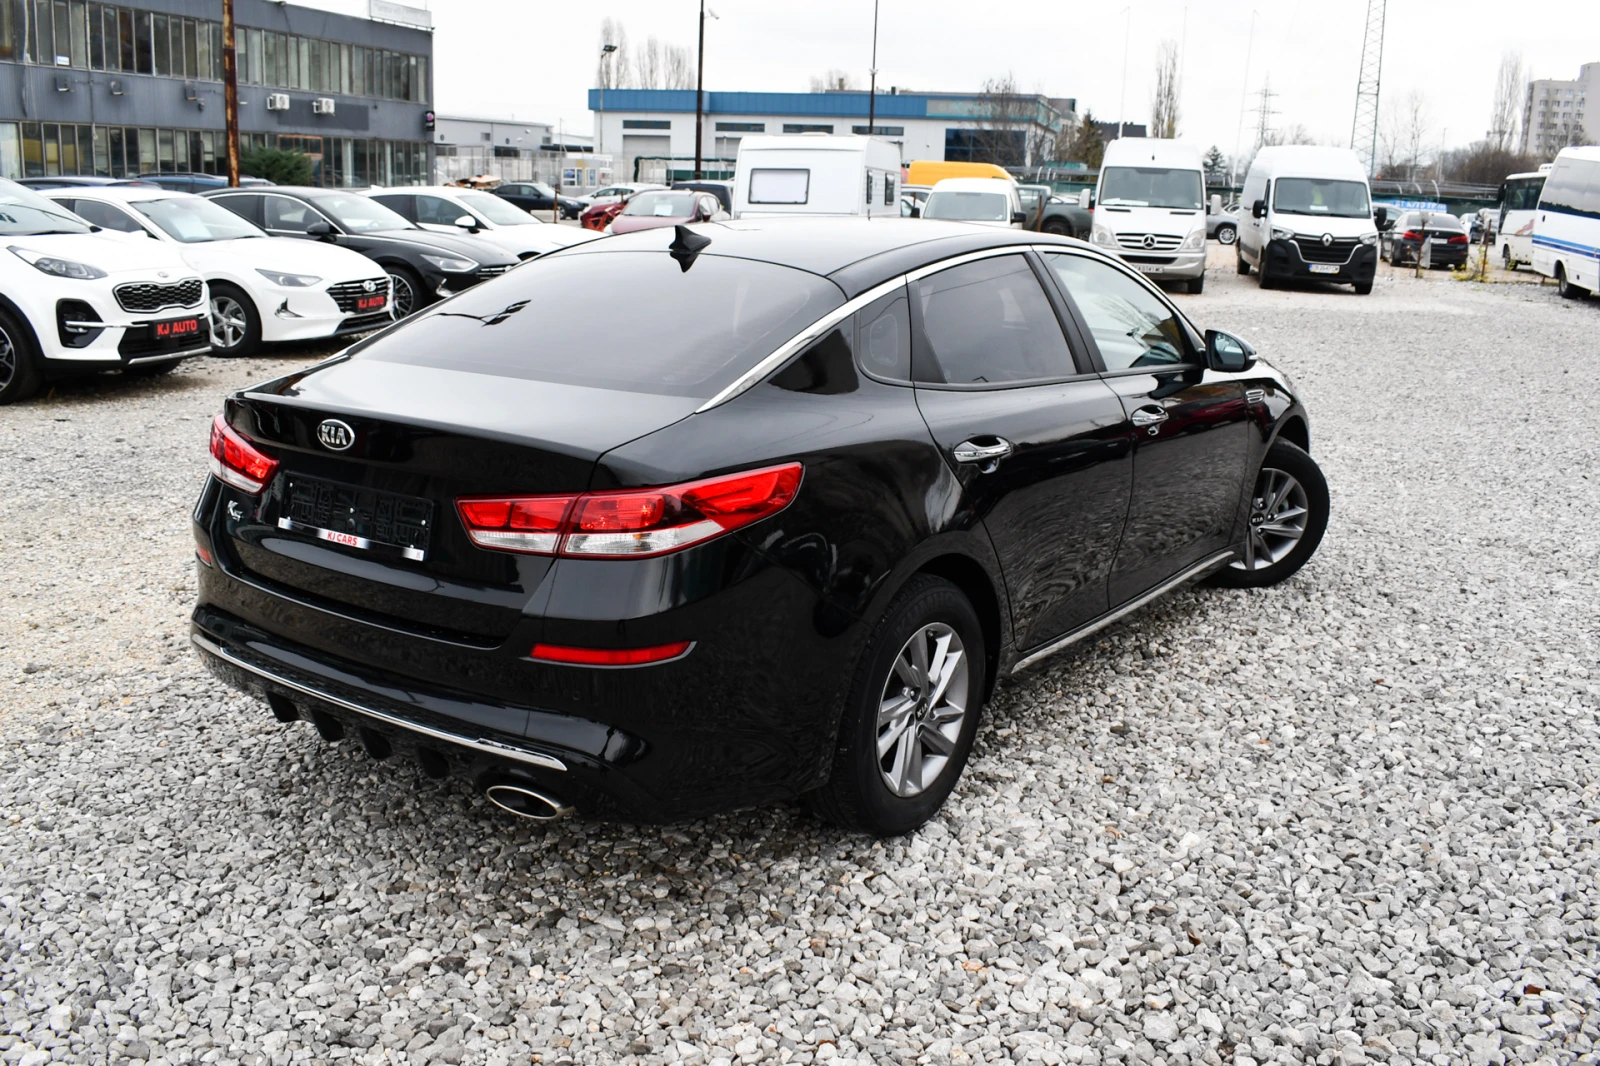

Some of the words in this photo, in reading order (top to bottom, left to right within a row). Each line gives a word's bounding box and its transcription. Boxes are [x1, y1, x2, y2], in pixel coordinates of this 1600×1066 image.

[157, 323, 170, 335] KJ
[172, 319, 197, 333] AUTO
[321, 424, 347, 445] KIA
[327, 531, 336, 540] KJ
[337, 533, 358, 546] CARS
[917, 702, 928, 718] KIA
